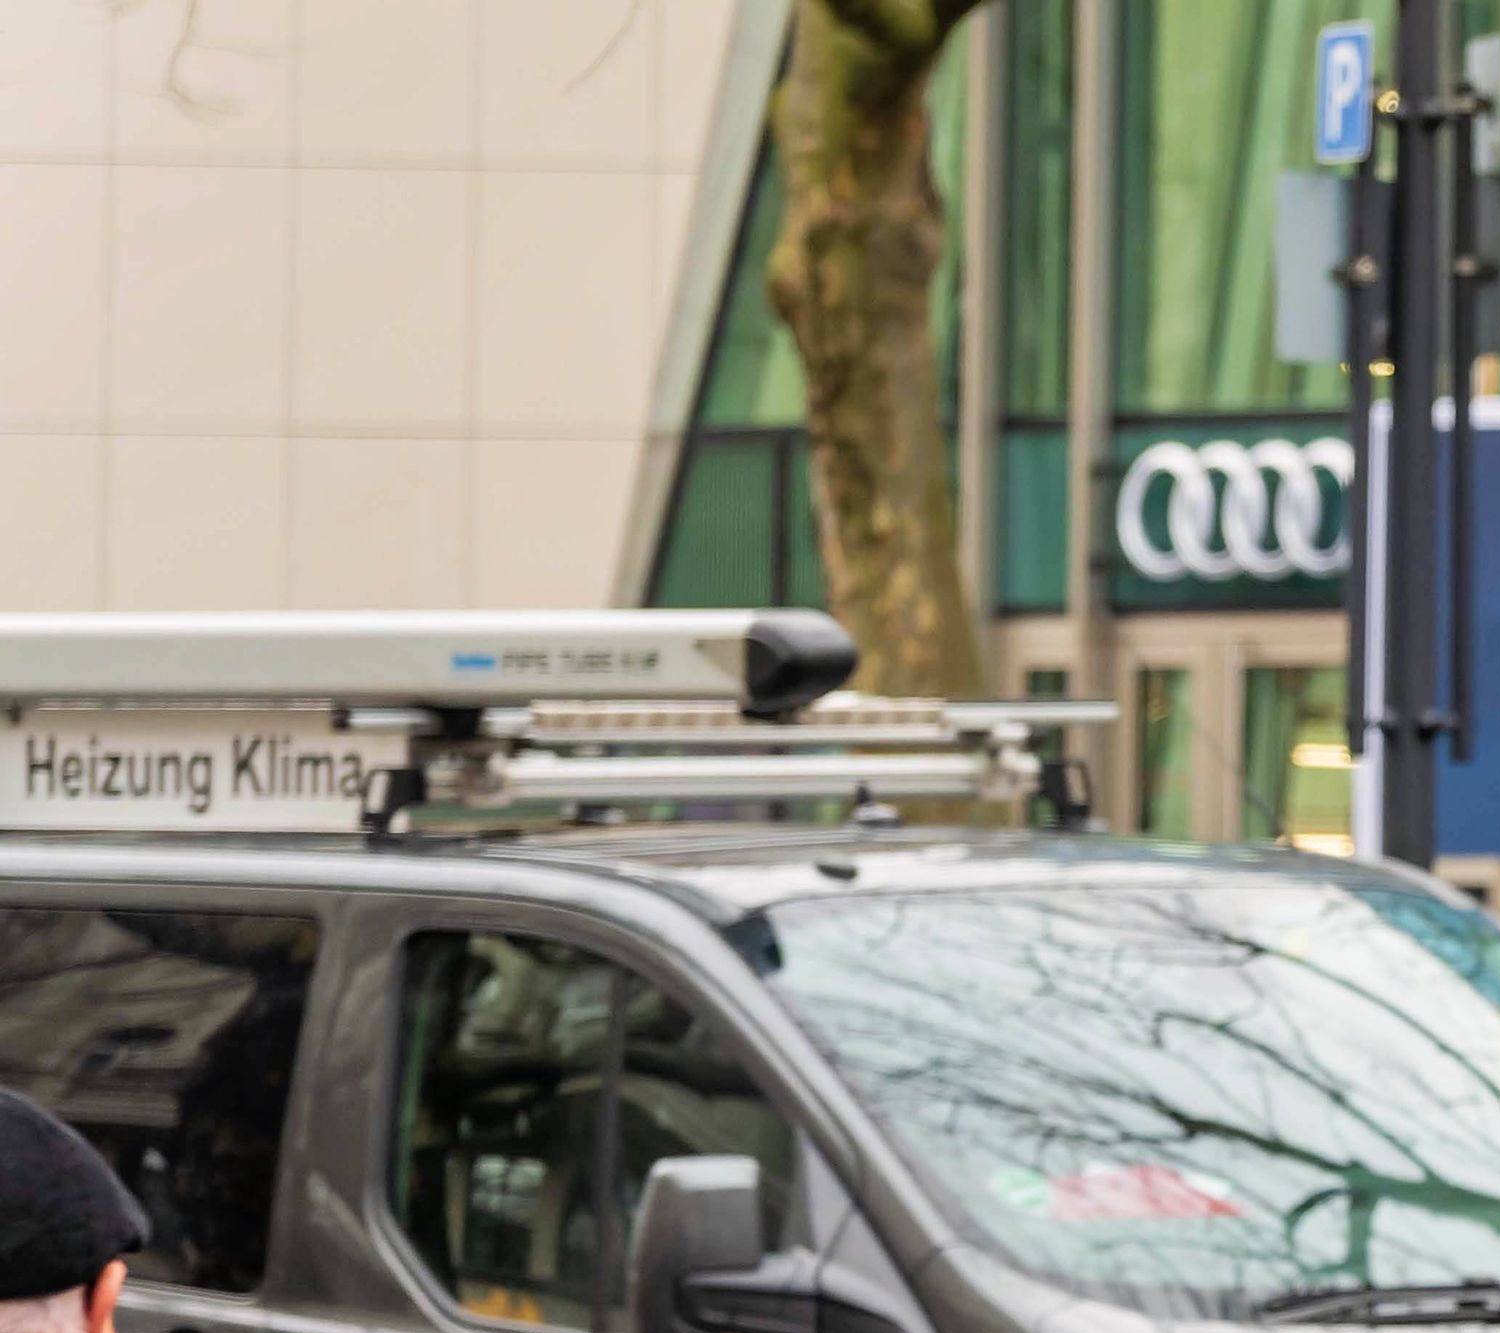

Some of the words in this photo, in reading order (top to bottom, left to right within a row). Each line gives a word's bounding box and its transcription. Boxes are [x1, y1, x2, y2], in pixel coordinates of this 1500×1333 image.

[1325, 41, 1361, 142] P
[26, 736, 212, 812] Heizung
[232, 735, 365, 797] Klima
